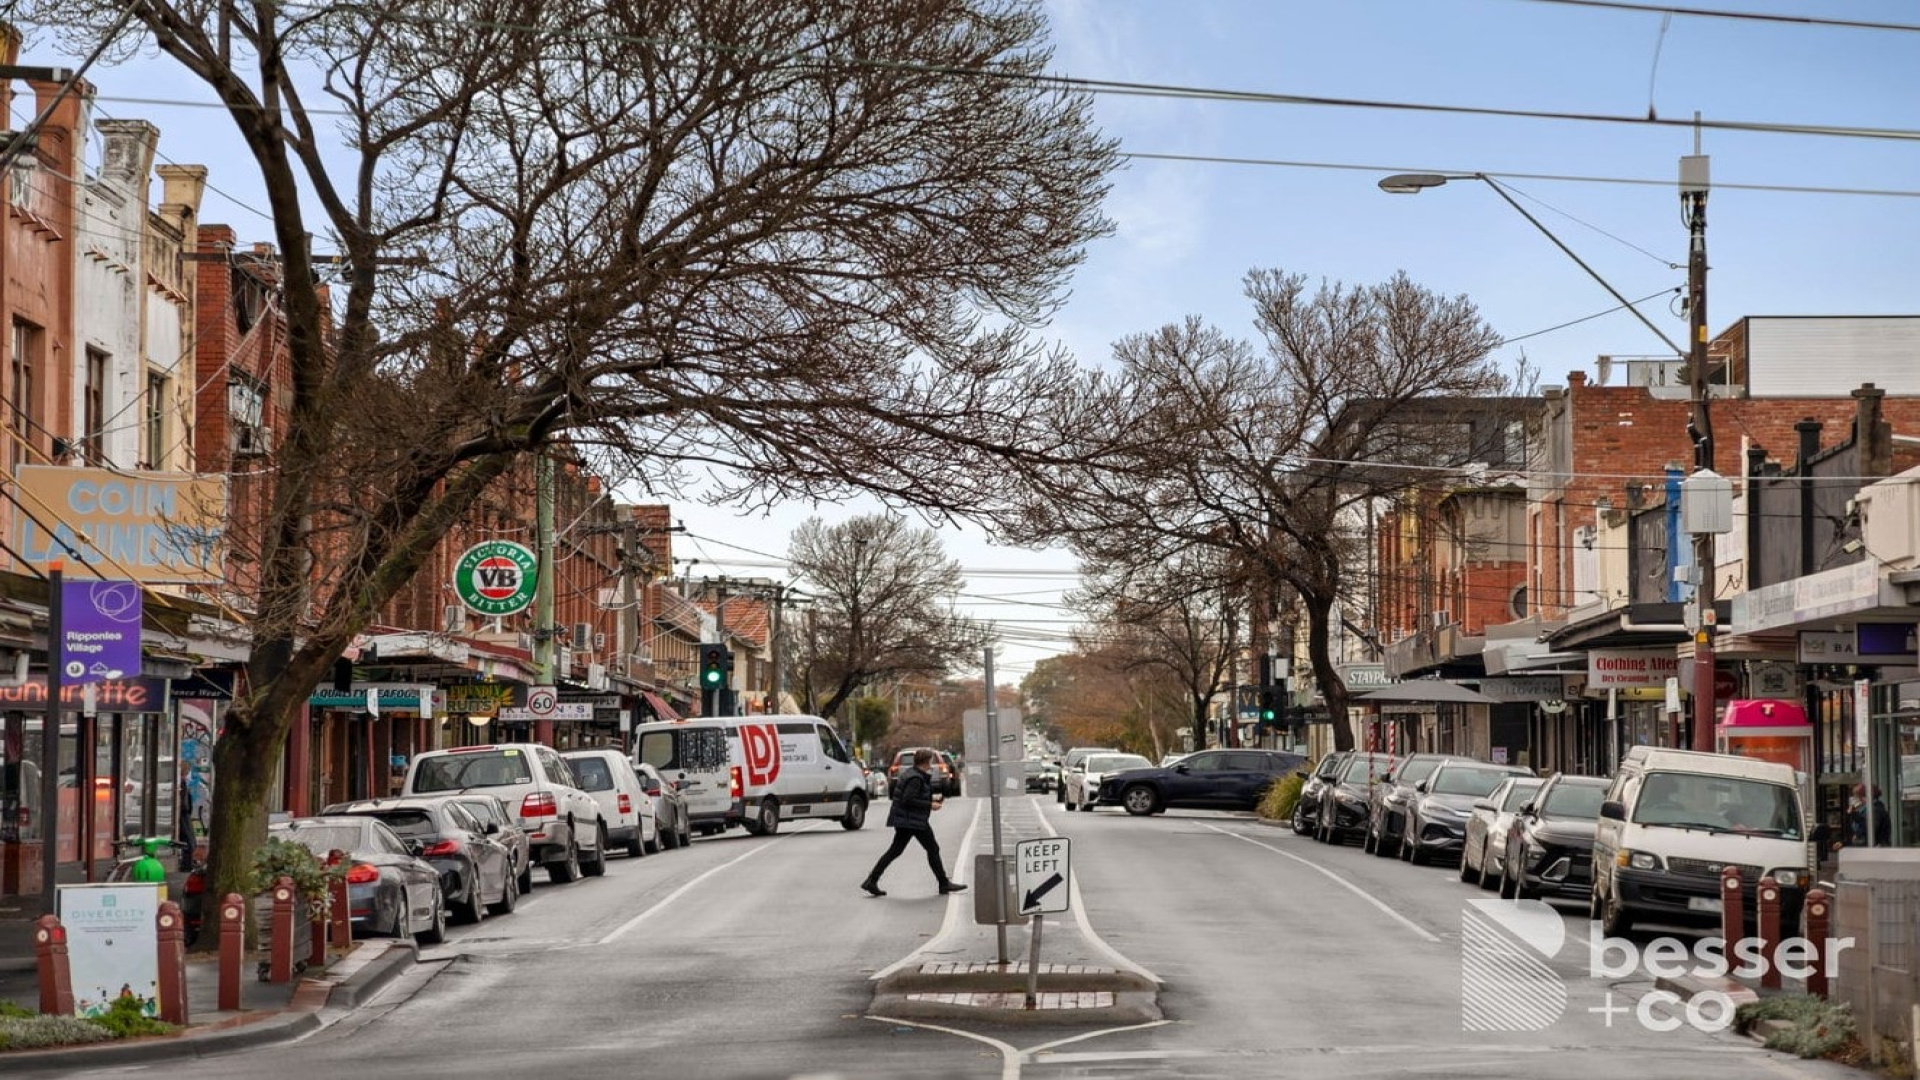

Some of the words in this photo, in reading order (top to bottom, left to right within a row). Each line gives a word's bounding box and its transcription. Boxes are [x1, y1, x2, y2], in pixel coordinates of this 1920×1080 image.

[67, 479, 177, 518] COIN
[22, 518, 222, 568] LAUNDRY
[463, 546, 531, 569] VICTORIA
[477, 569, 517, 588] VB
[468, 592, 528, 610] BITTER
[66, 631, 122, 642] Ripponlea
[66, 643, 103, 653] Village
[1596, 656, 1646, 671] Clothing
[1650, 656, 1679, 670] Alter
[532, 696, 553, 710] 60
[1025, 844, 1061, 858] KEEP
[1025, 860, 1059, 873] LEFT
